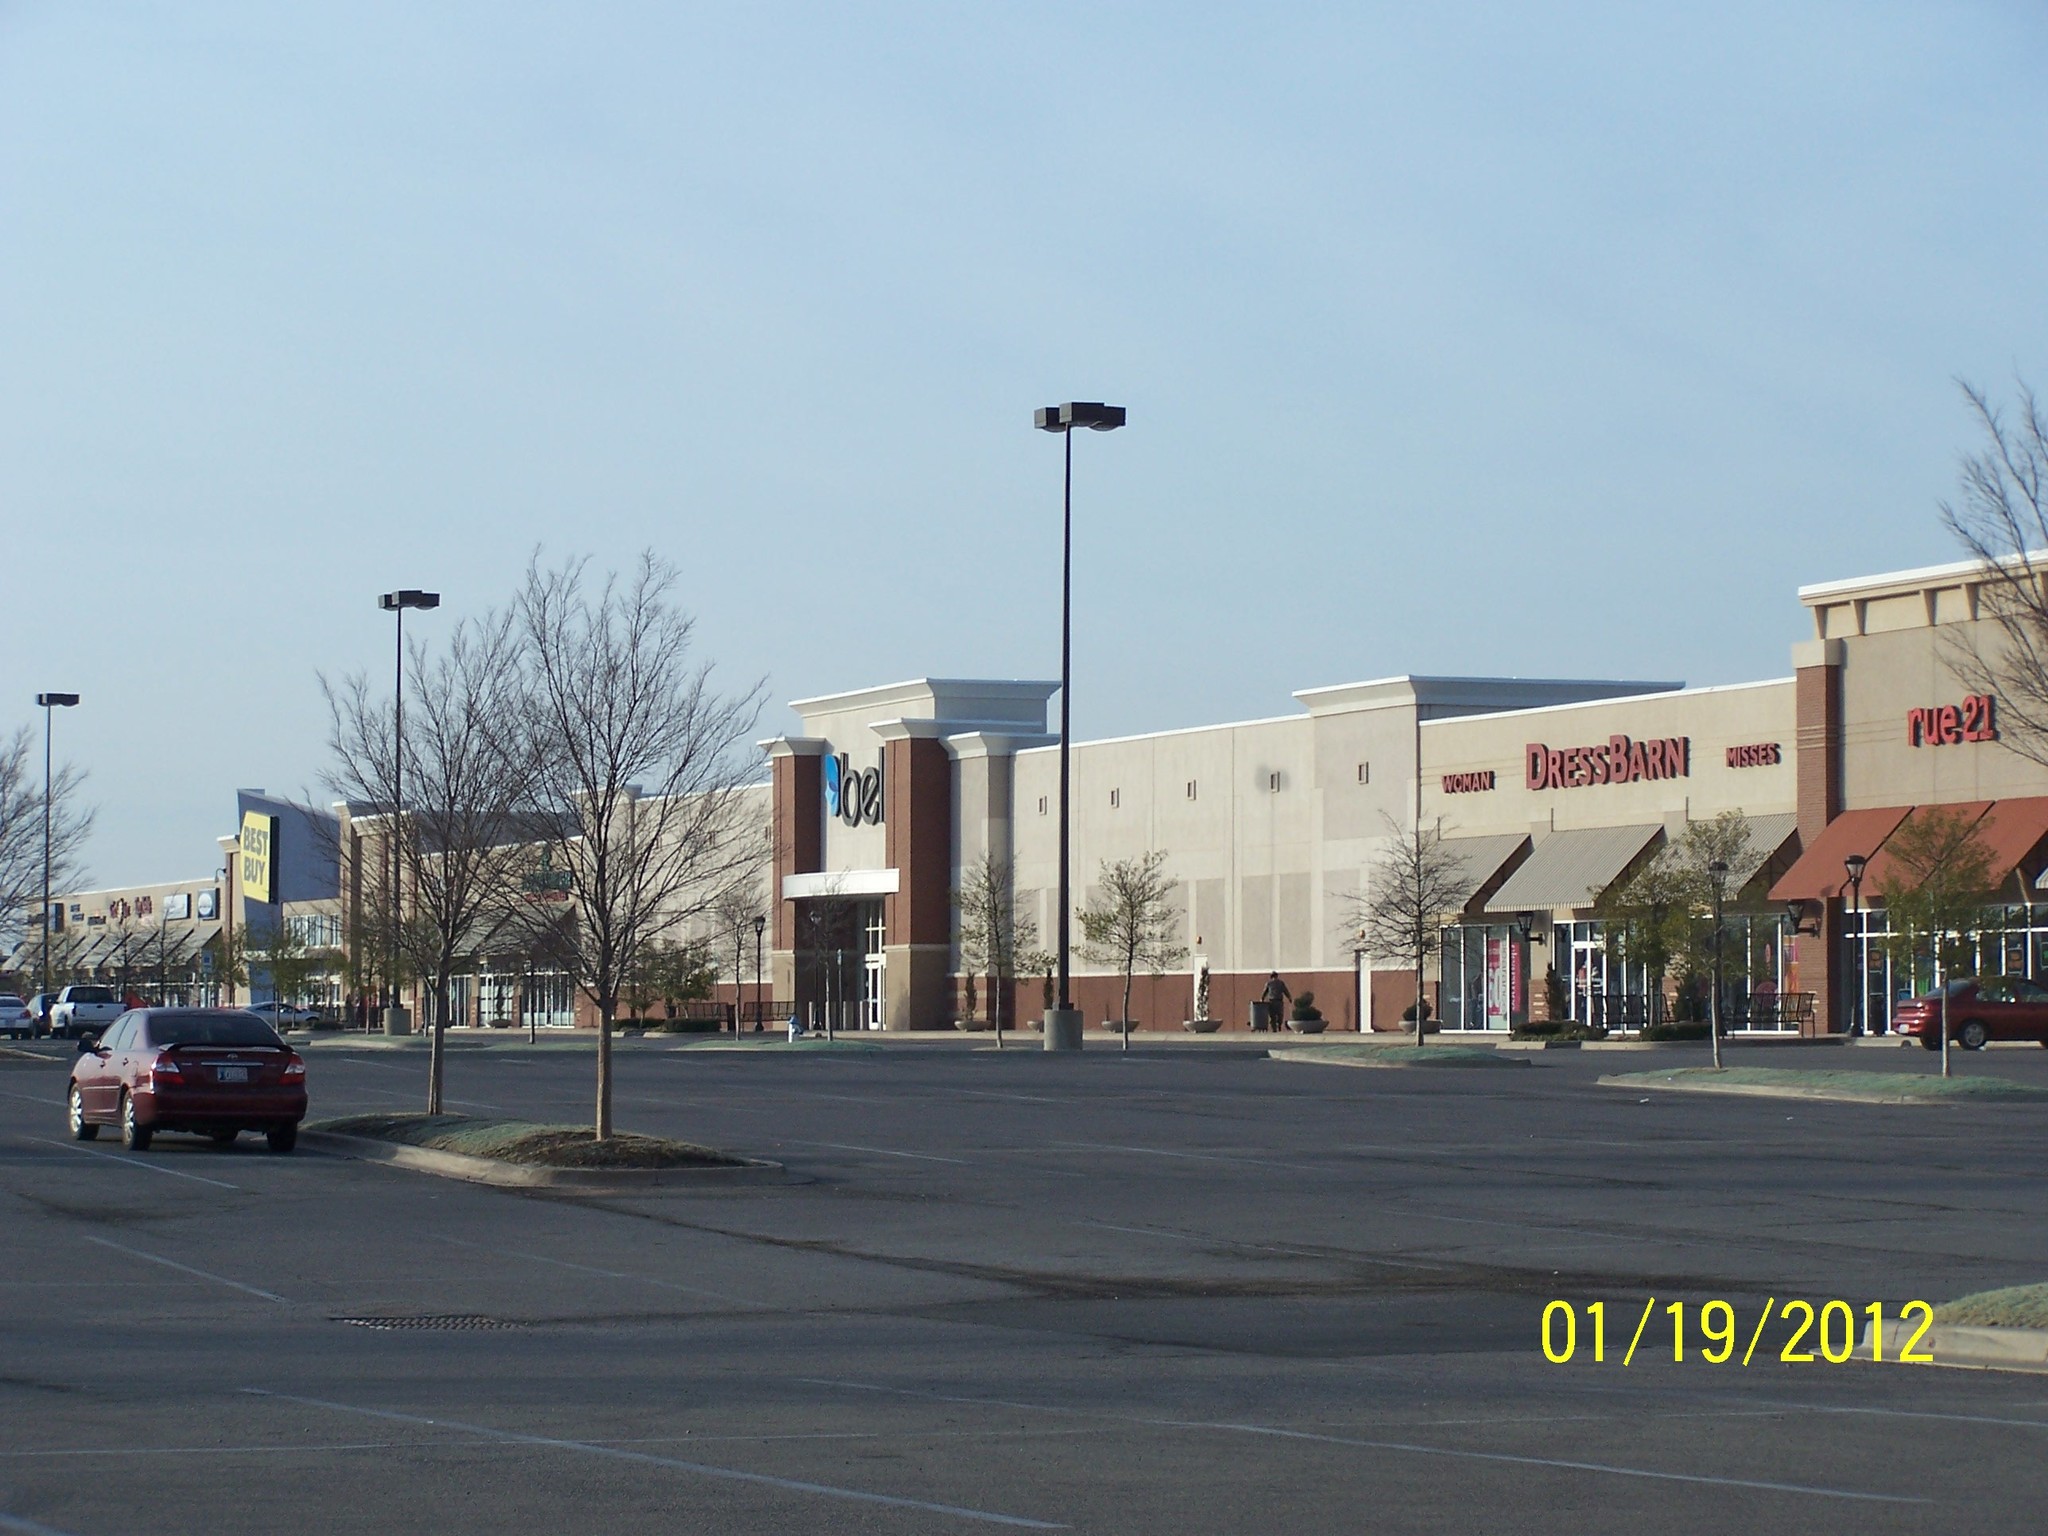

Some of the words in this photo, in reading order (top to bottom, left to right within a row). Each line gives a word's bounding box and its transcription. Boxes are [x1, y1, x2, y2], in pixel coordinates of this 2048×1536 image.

[1726, 743, 1781, 768] MISSES
[1442, 770, 1495, 794] WOMAN
[243, 825, 269, 857] BEST
[243, 855, 266, 886] BUY
